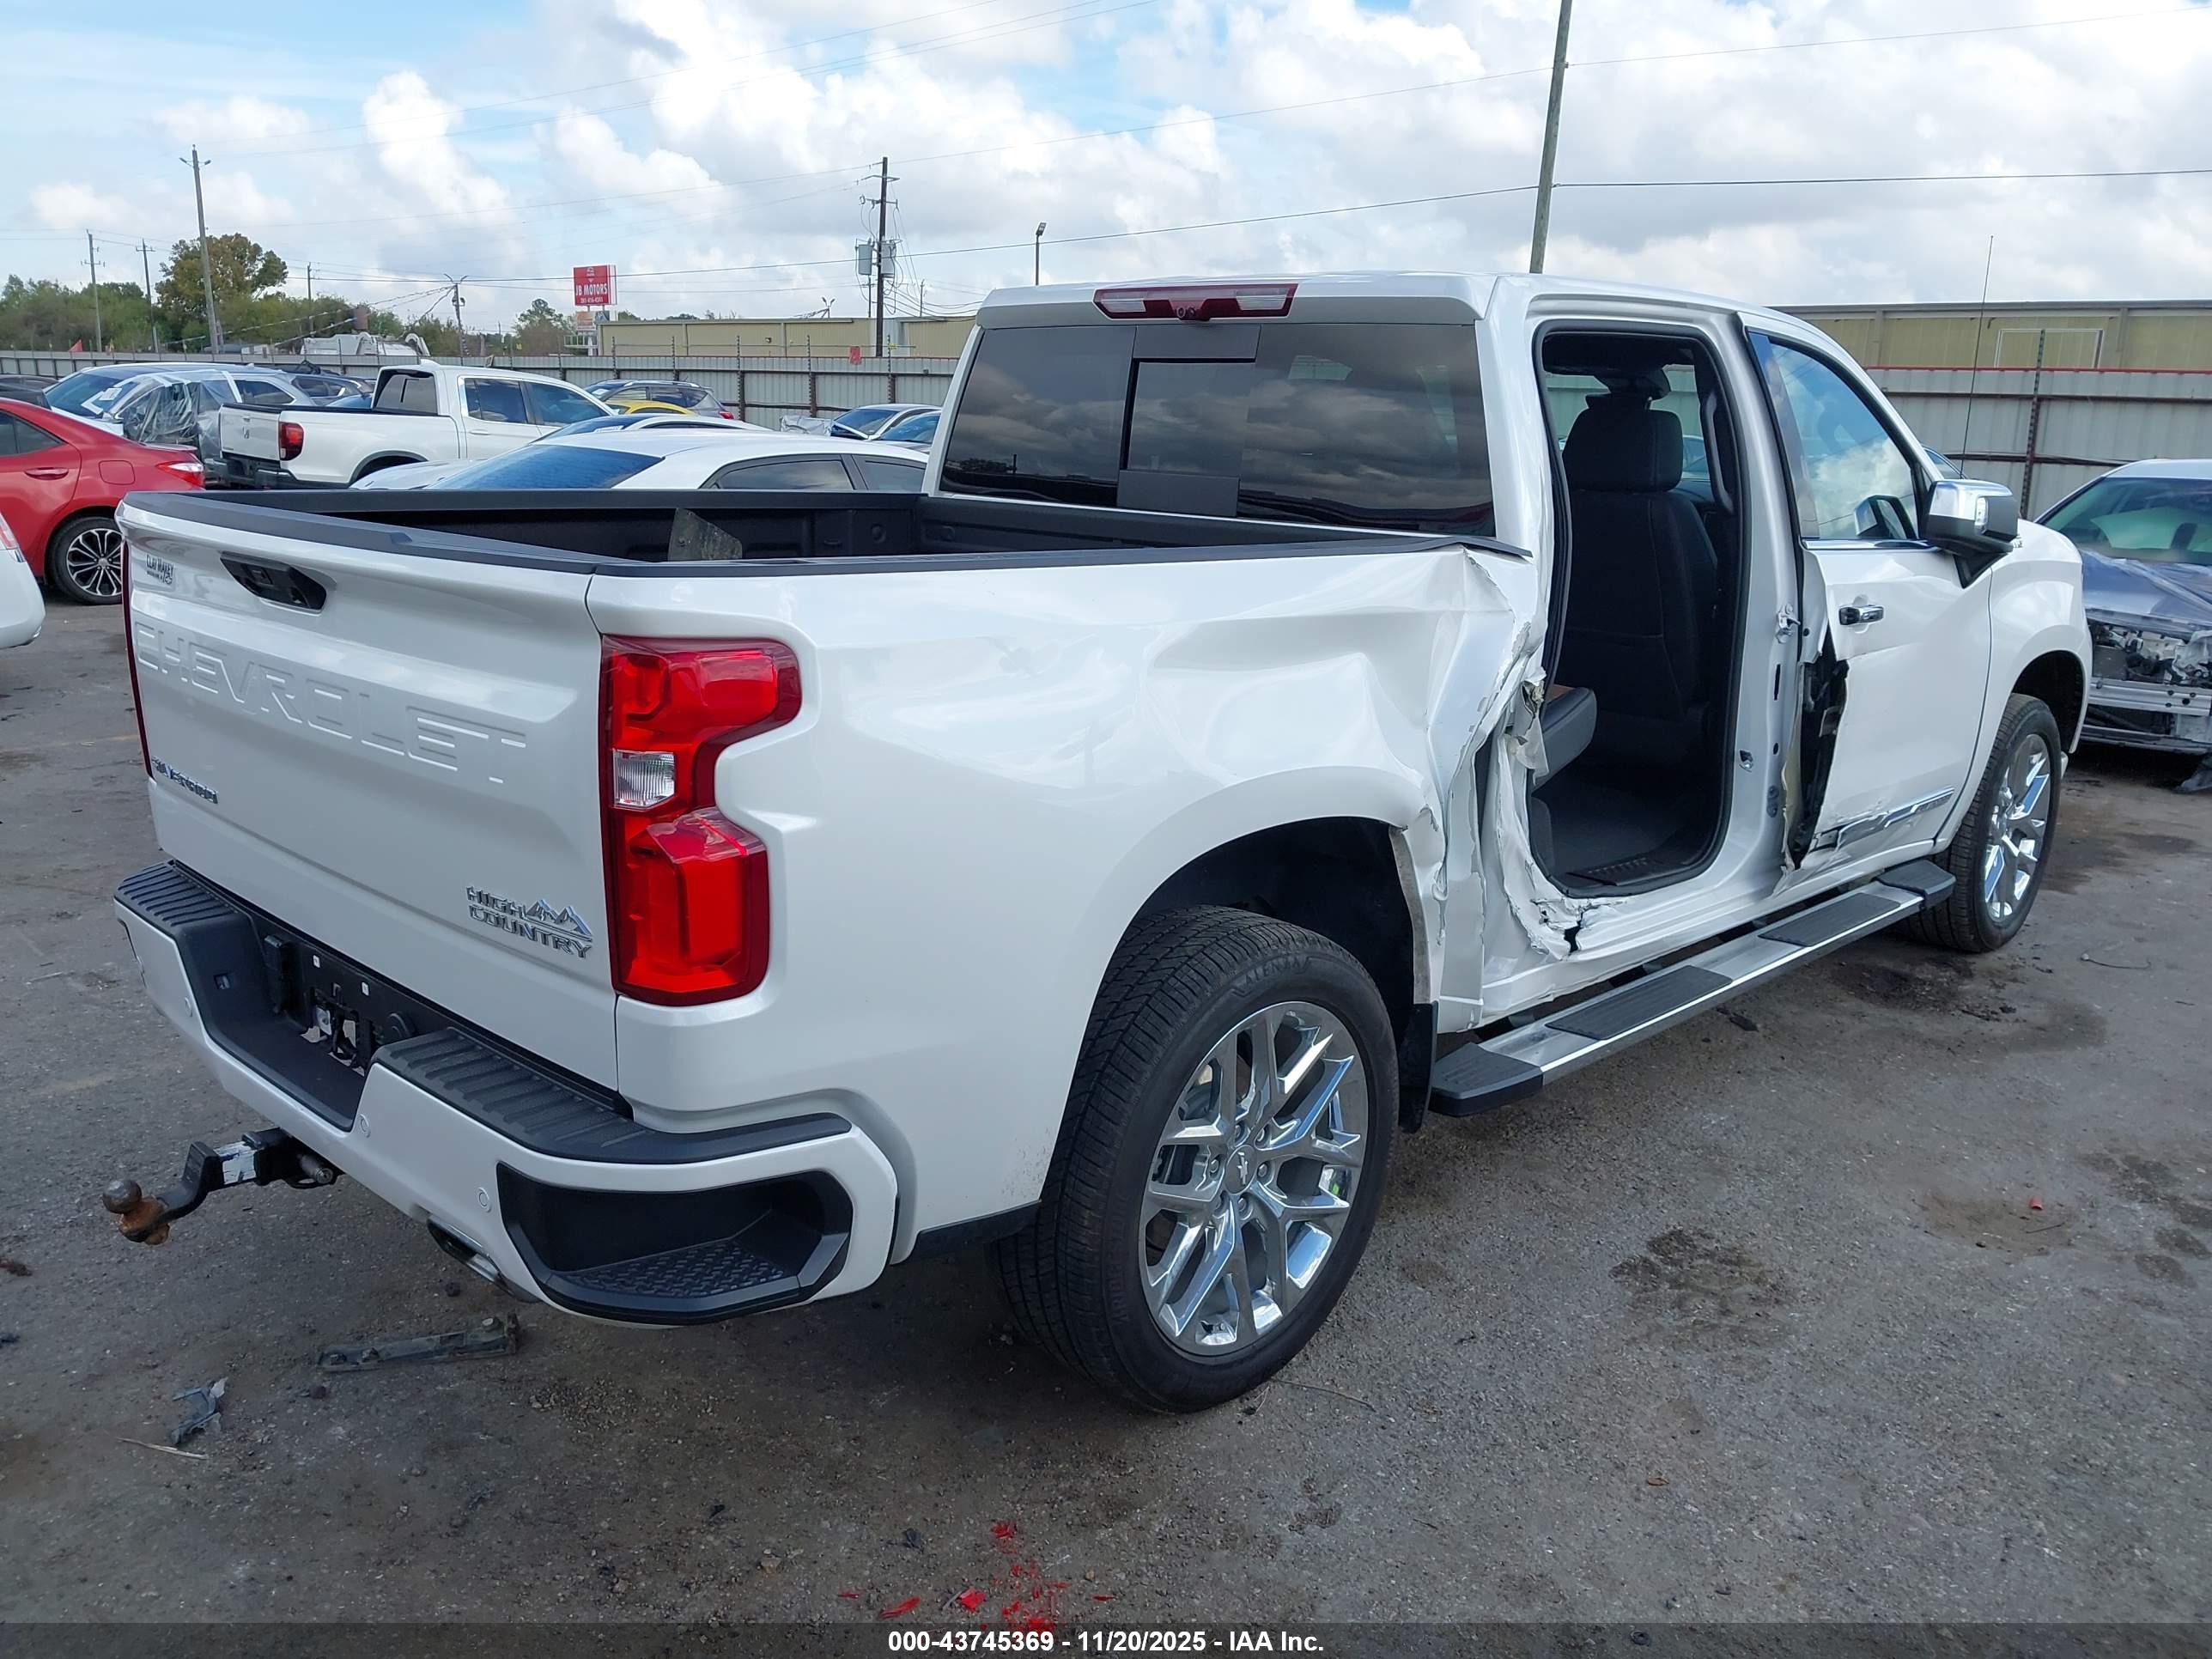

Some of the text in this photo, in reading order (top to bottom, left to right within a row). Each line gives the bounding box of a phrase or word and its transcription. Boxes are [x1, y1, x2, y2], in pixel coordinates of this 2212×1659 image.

[575, 283, 607, 296] JB MOTORS
[135, 622, 526, 785] CHEVROLET
[466, 886, 527, 920] HIGH
[468, 904, 592, 958] COUNTRY
